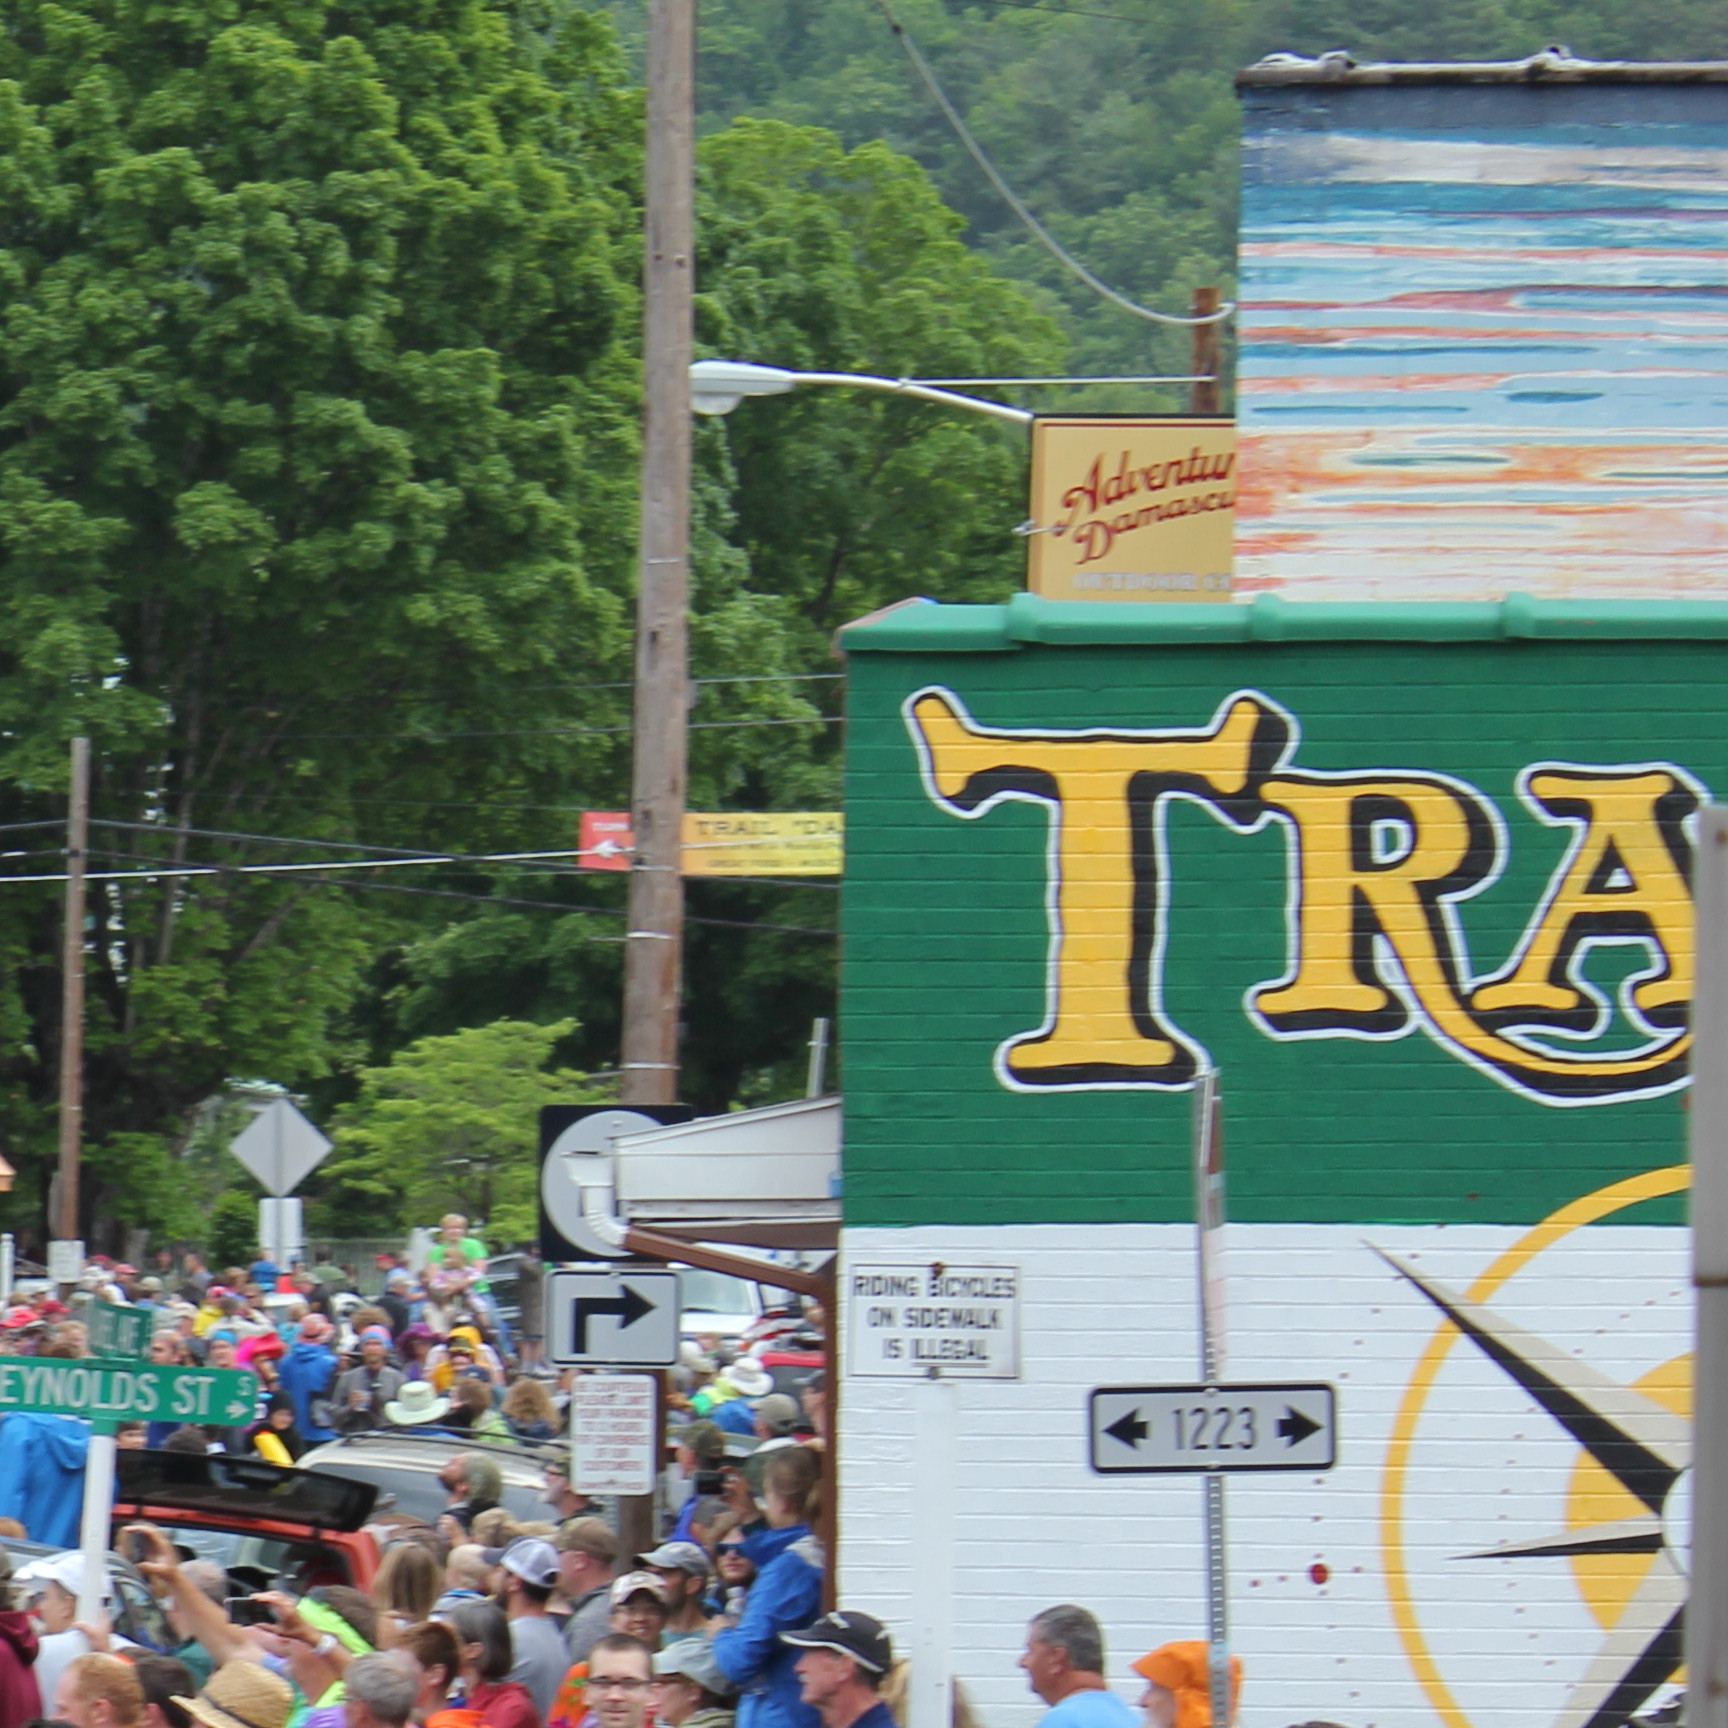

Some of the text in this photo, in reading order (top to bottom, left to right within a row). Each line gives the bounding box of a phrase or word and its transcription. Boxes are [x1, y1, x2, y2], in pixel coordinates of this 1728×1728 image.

[696, 820, 778, 835] TRAIL
[853, 1275, 1016, 1298] RIDING BICYCLES
[867, 1306, 1002, 1329] ON SIDEWALK
[882, 1338, 989, 1360] IS ILLEGAL
[173, 1374, 217, 1416] ST
[1172, 1406, 1258, 1451] 1223
